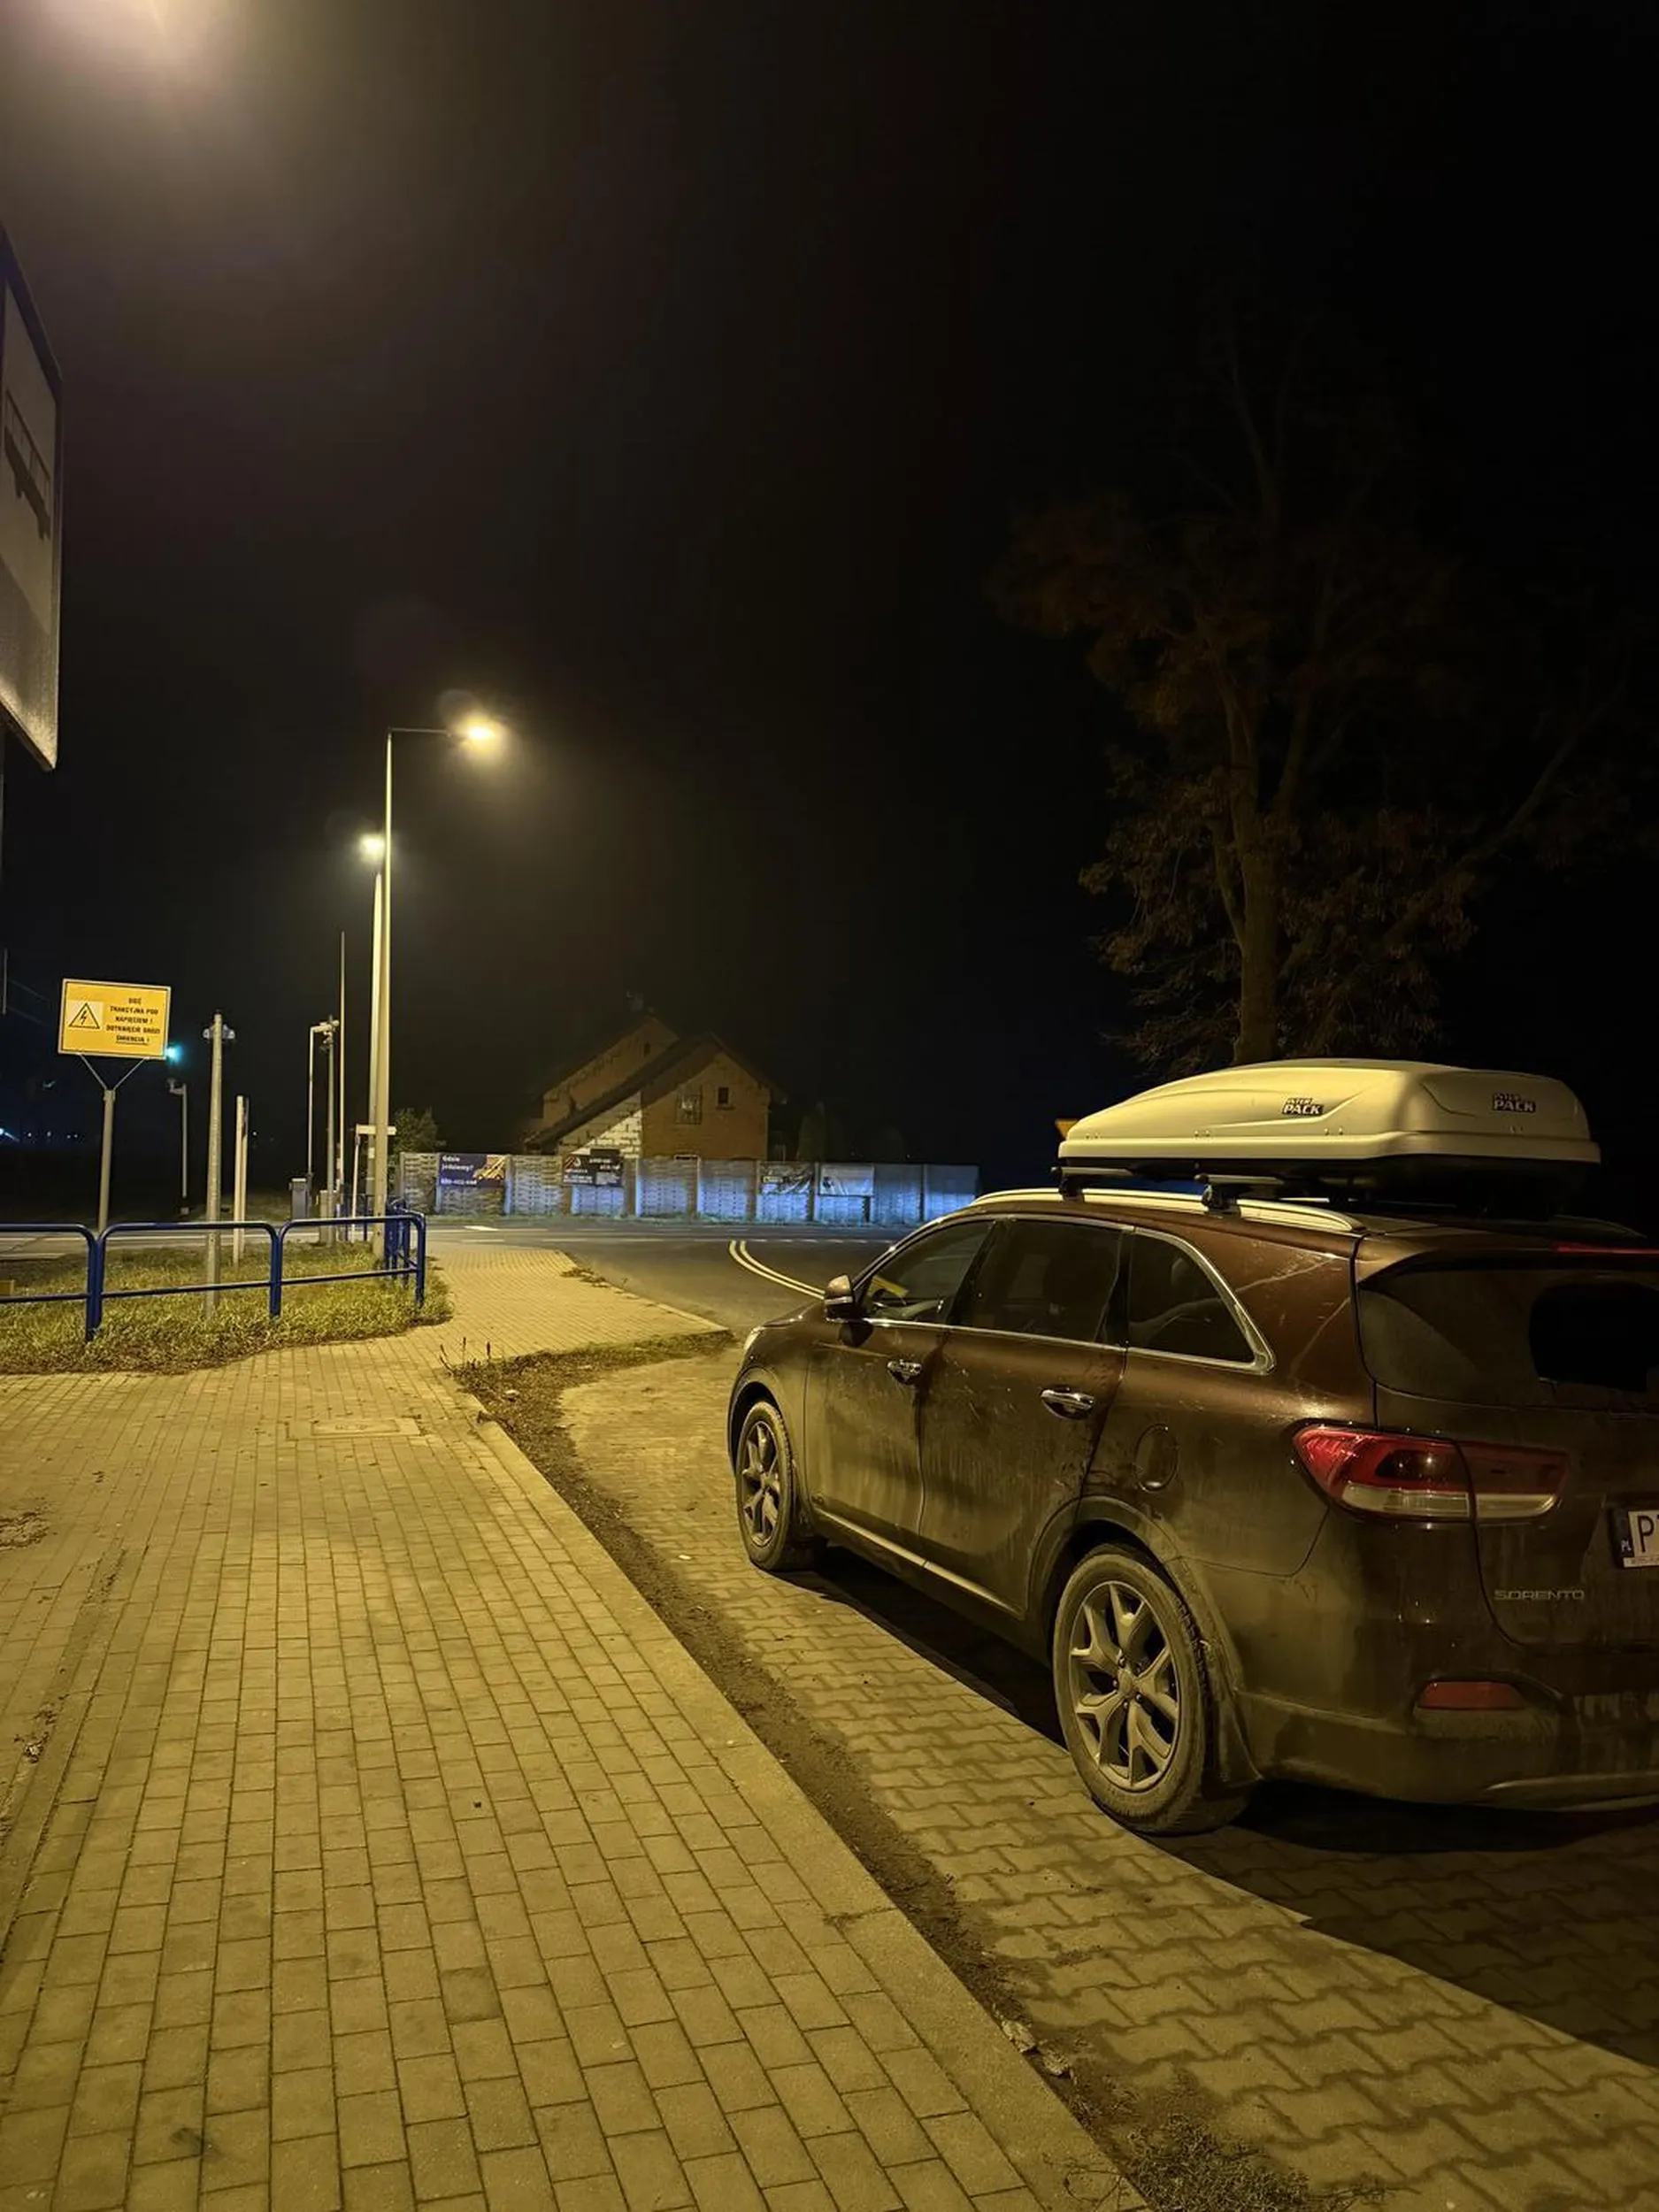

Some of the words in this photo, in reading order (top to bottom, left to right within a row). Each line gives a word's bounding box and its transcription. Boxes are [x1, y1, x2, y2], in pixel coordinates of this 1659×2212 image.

[1283, 1104, 1320, 1115] PACK
[1494, 1100, 1534, 1112] PACK
[1494, 1590, 1585, 1601] SORENTO
